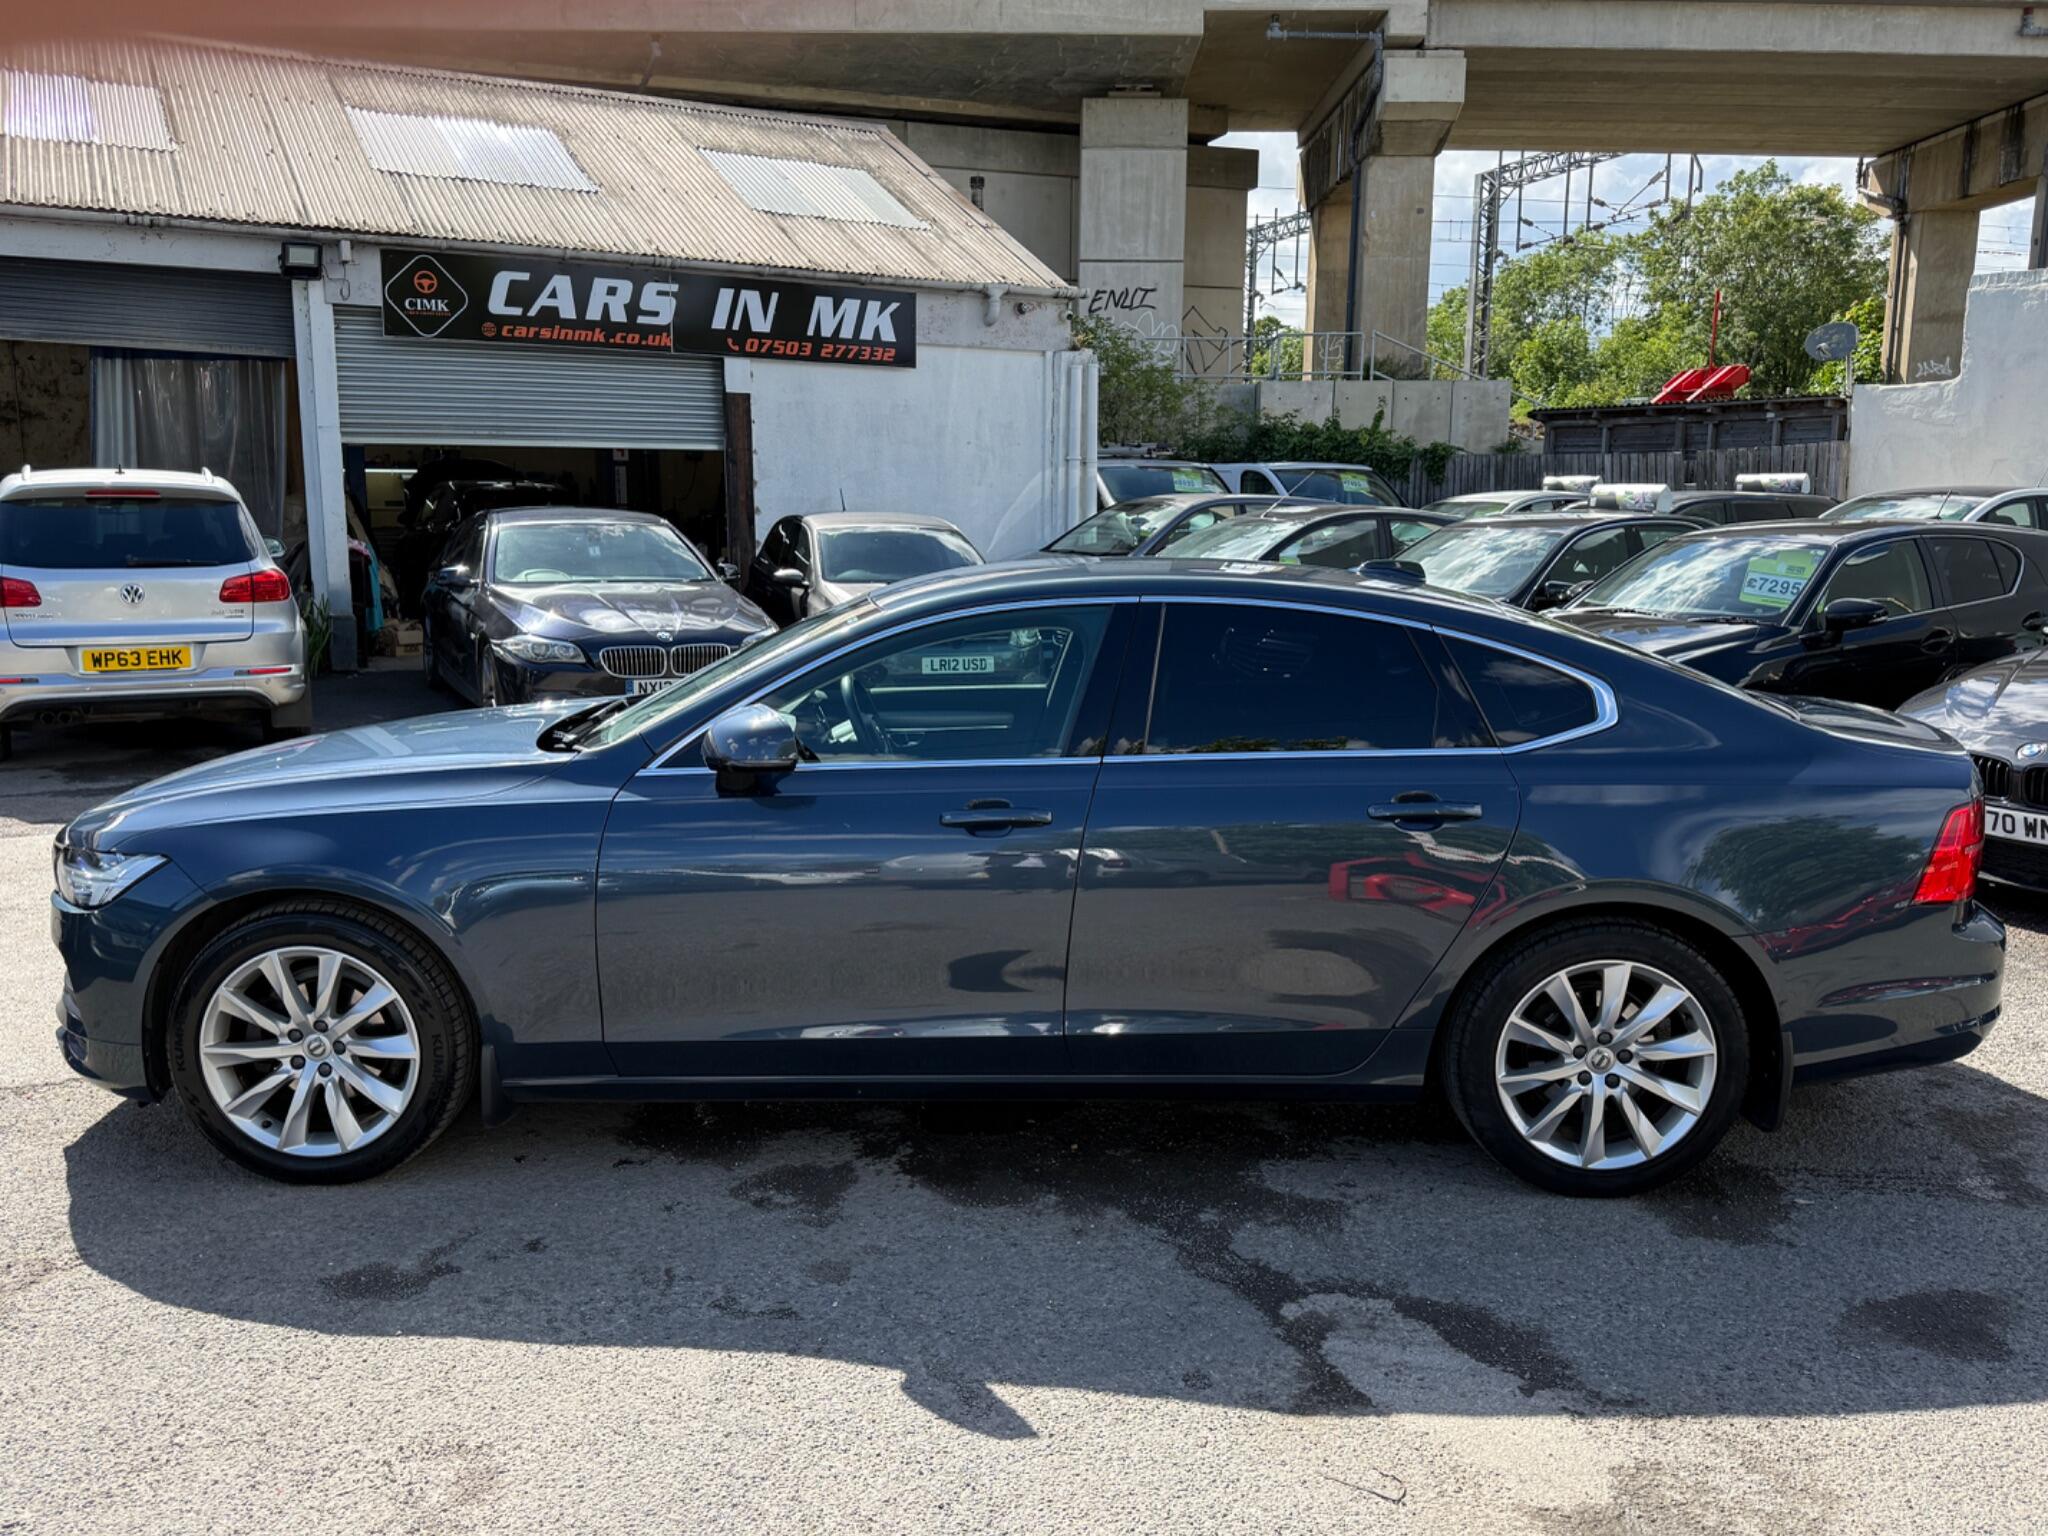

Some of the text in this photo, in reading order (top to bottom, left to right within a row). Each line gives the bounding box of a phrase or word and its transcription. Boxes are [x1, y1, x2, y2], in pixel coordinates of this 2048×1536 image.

[404, 297, 449, 312] CIMK
[487, 270, 901, 342] CARS IN MK
[501, 324, 672, 347] carsinmk.co.uk
[744, 337, 896, 362] 07503 277332
[1746, 576, 1802, 596] £7295
[91, 649, 184, 668] WP63 EHK
[930, 657, 988, 672] LR12 USD
[1986, 810, 2016, 835] 70
